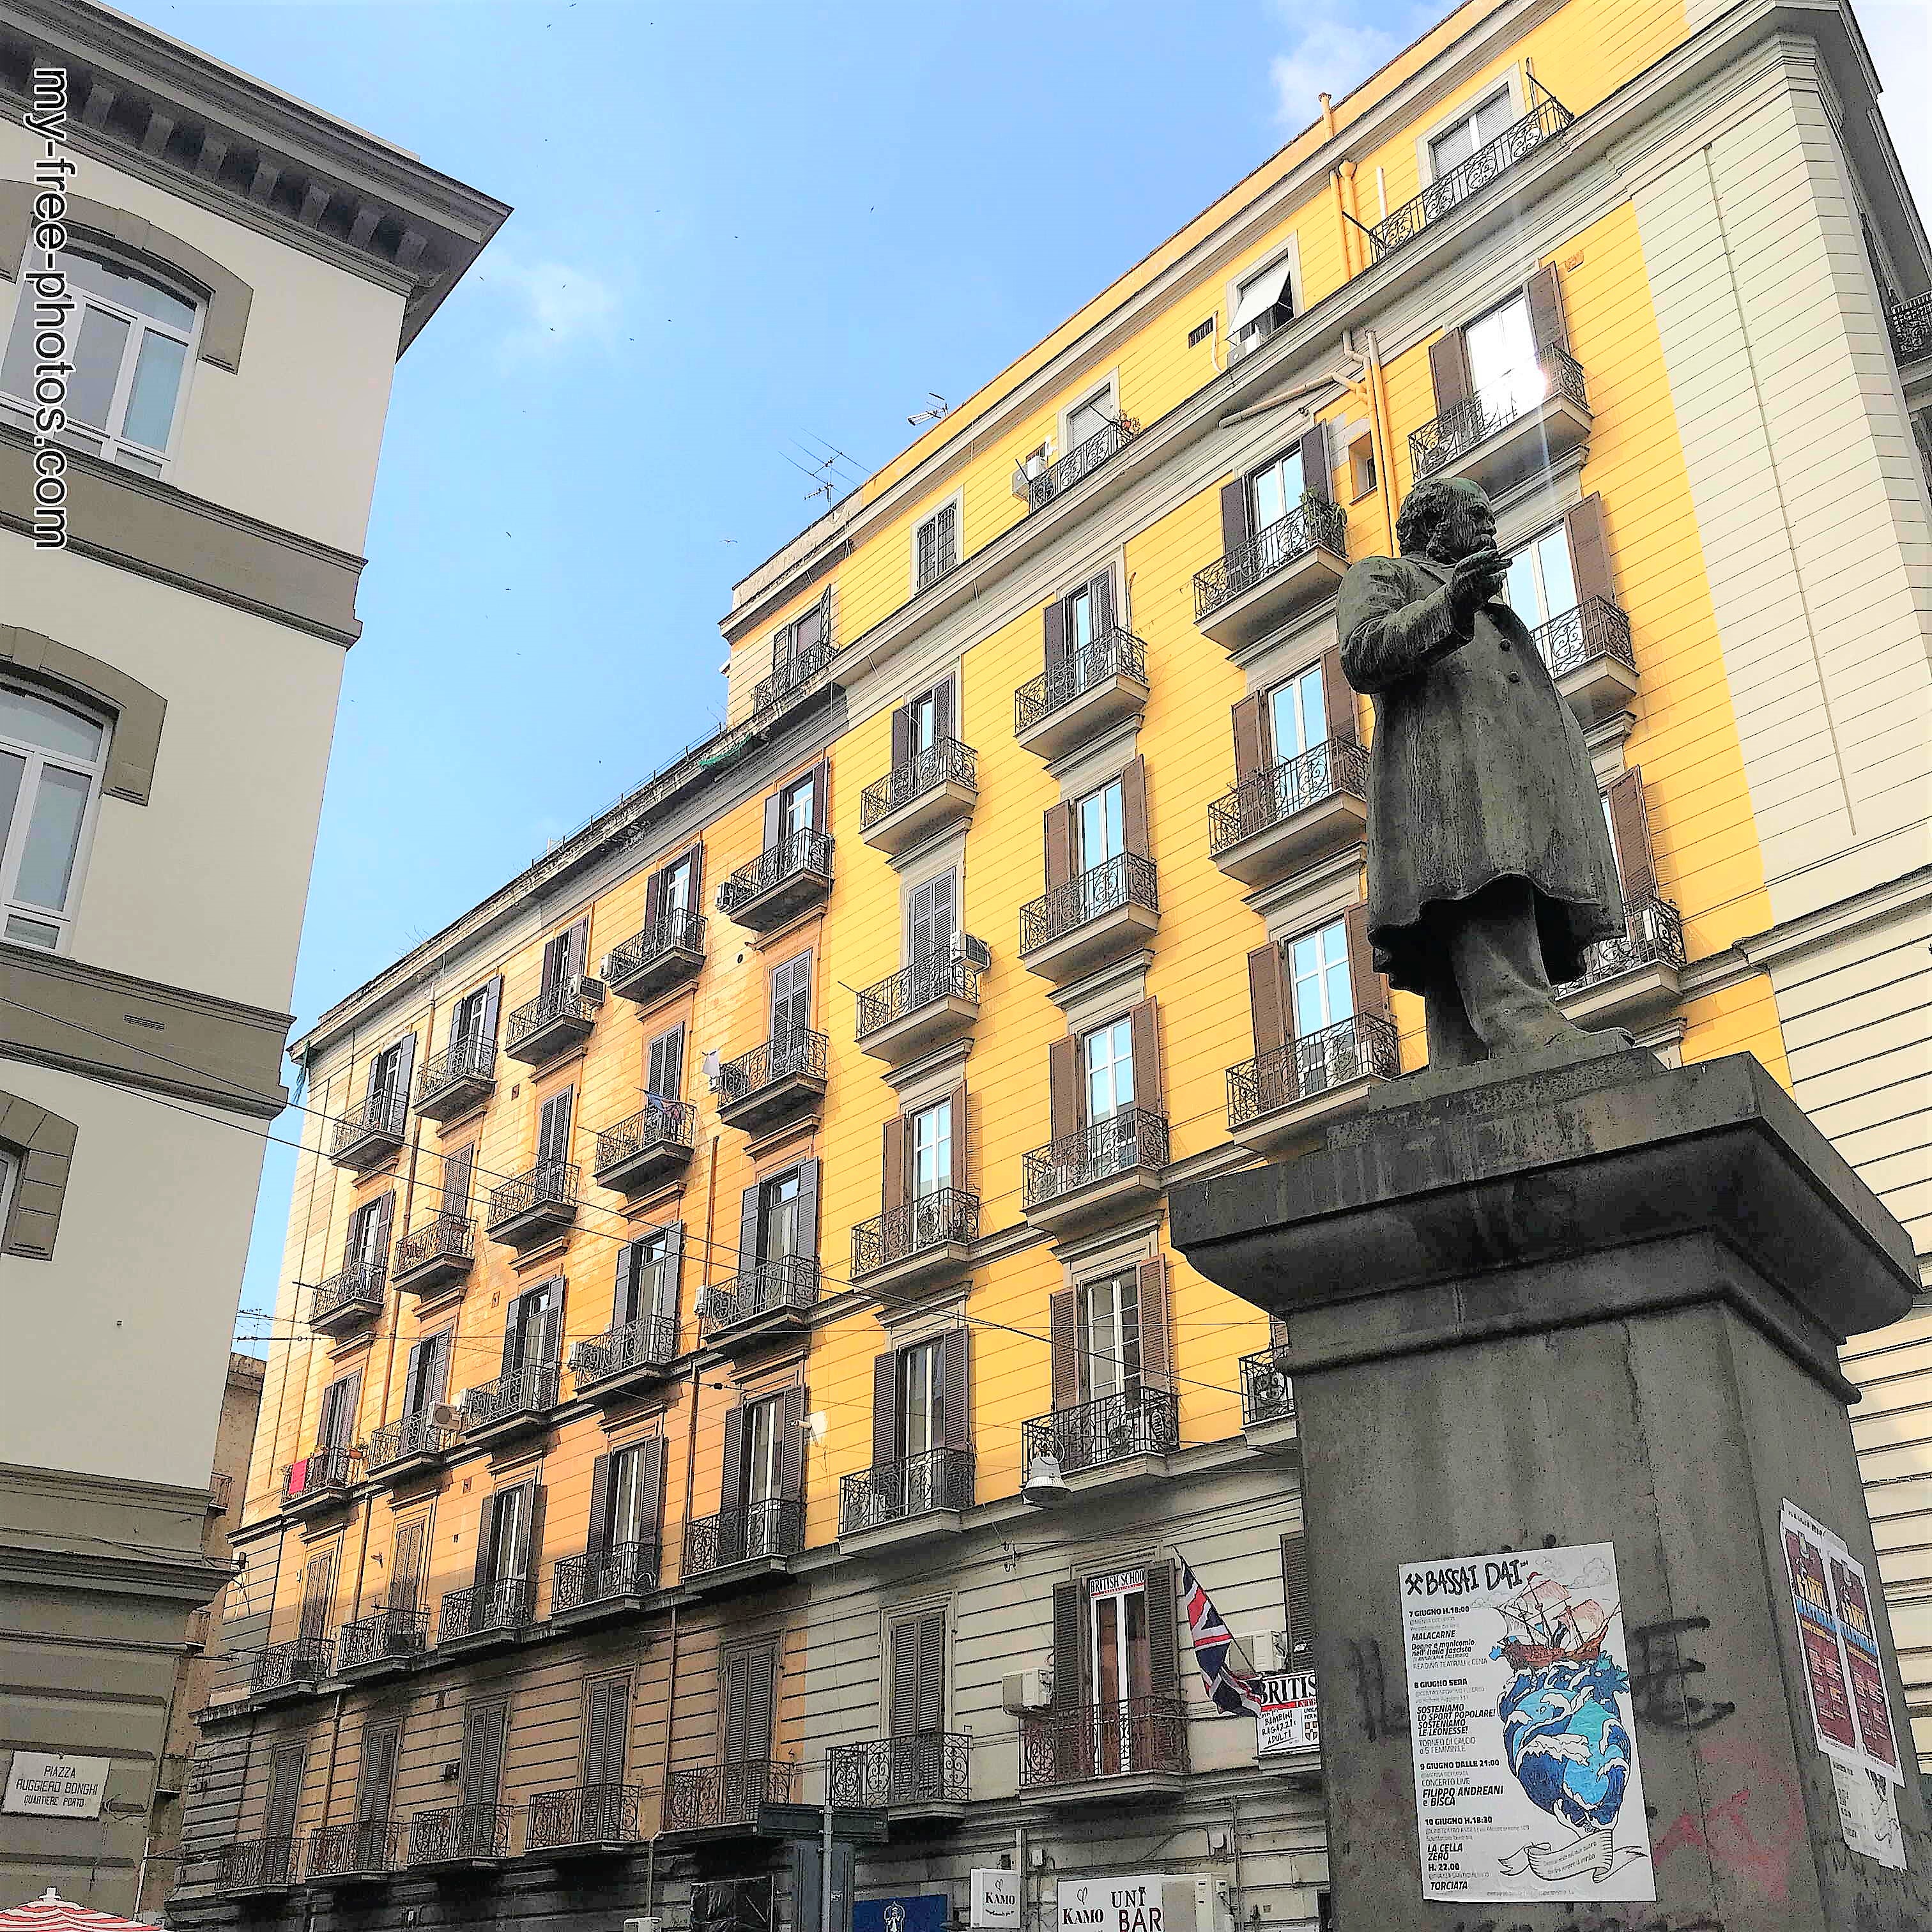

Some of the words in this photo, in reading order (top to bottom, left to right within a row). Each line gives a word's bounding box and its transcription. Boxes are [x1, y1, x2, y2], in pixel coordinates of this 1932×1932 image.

[1425, 1565, 1480, 1596] BASSAI
[1484, 1559, 1523, 1591] DAI
[1091, 1575, 1119, 1593] BRITISH
[1414, 1608, 1442, 1617] GIUGNO
[1411, 1630, 1456, 1641] MALACARNE
[1439, 1638, 1475, 1648] manicomio
[1420, 1680, 1448, 1688] GIUGNO
[1448, 1678, 1468, 1686] SERA
[1417, 1703, 1464, 1714] SOSTENIAMO
[1264, 1710, 1292, 1726] BAMBINI
[1429, 1712, 1453, 1721] SPORT
[1454, 1708, 1496, 1719] POPOLARE!
[1418, 1719, 1466, 1729] SOSTENIAMO
[1429, 1726, 1468, 1736] LEONESSE!
[1268, 1729, 1291, 1745] ADULTI
[1419, 1738, 1445, 1747] TORNEO
[1454, 1736, 1476, 1745] CALCIO
[1426, 1761, 1454, 1770] GIUGNO
[1455, 1760, 1478, 1768] DALLE
[1479, 1759, 1499, 1767] 21:00
[43, 1765, 76, 1779] PIAZZA
[15, 1779, 61, 1793] RUGGIERO
[65, 1782, 98, 1795] BONGHI
[1422, 1778, 1455, 1787] CONCERTO
[1423, 1788, 1455, 1798] FILIPPO
[1457, 1785, 1504, 1797] ANDREANI
[24, 1795, 59, 1806] QUARTIERE
[63, 1797, 84, 1807] PORTO
[1434, 1817, 1463, 1825] GIUGNO
[1427, 1844, 1437, 1853] LA
[1439, 1843, 1463, 1852] CELLA
[1427, 1852, 1449, 1861] ZERO
[1438, 1862, 1460, 1871] 22.00
[1430, 1880, 1468, 1890] TORCIATA
[985, 1892, 1015, 1906] KAMO
[1110, 1887, 1146, 1908] UNI
[1062, 1908, 1105, 1925] KAMO
[1118, 1906, 1162, 1932] BAR
